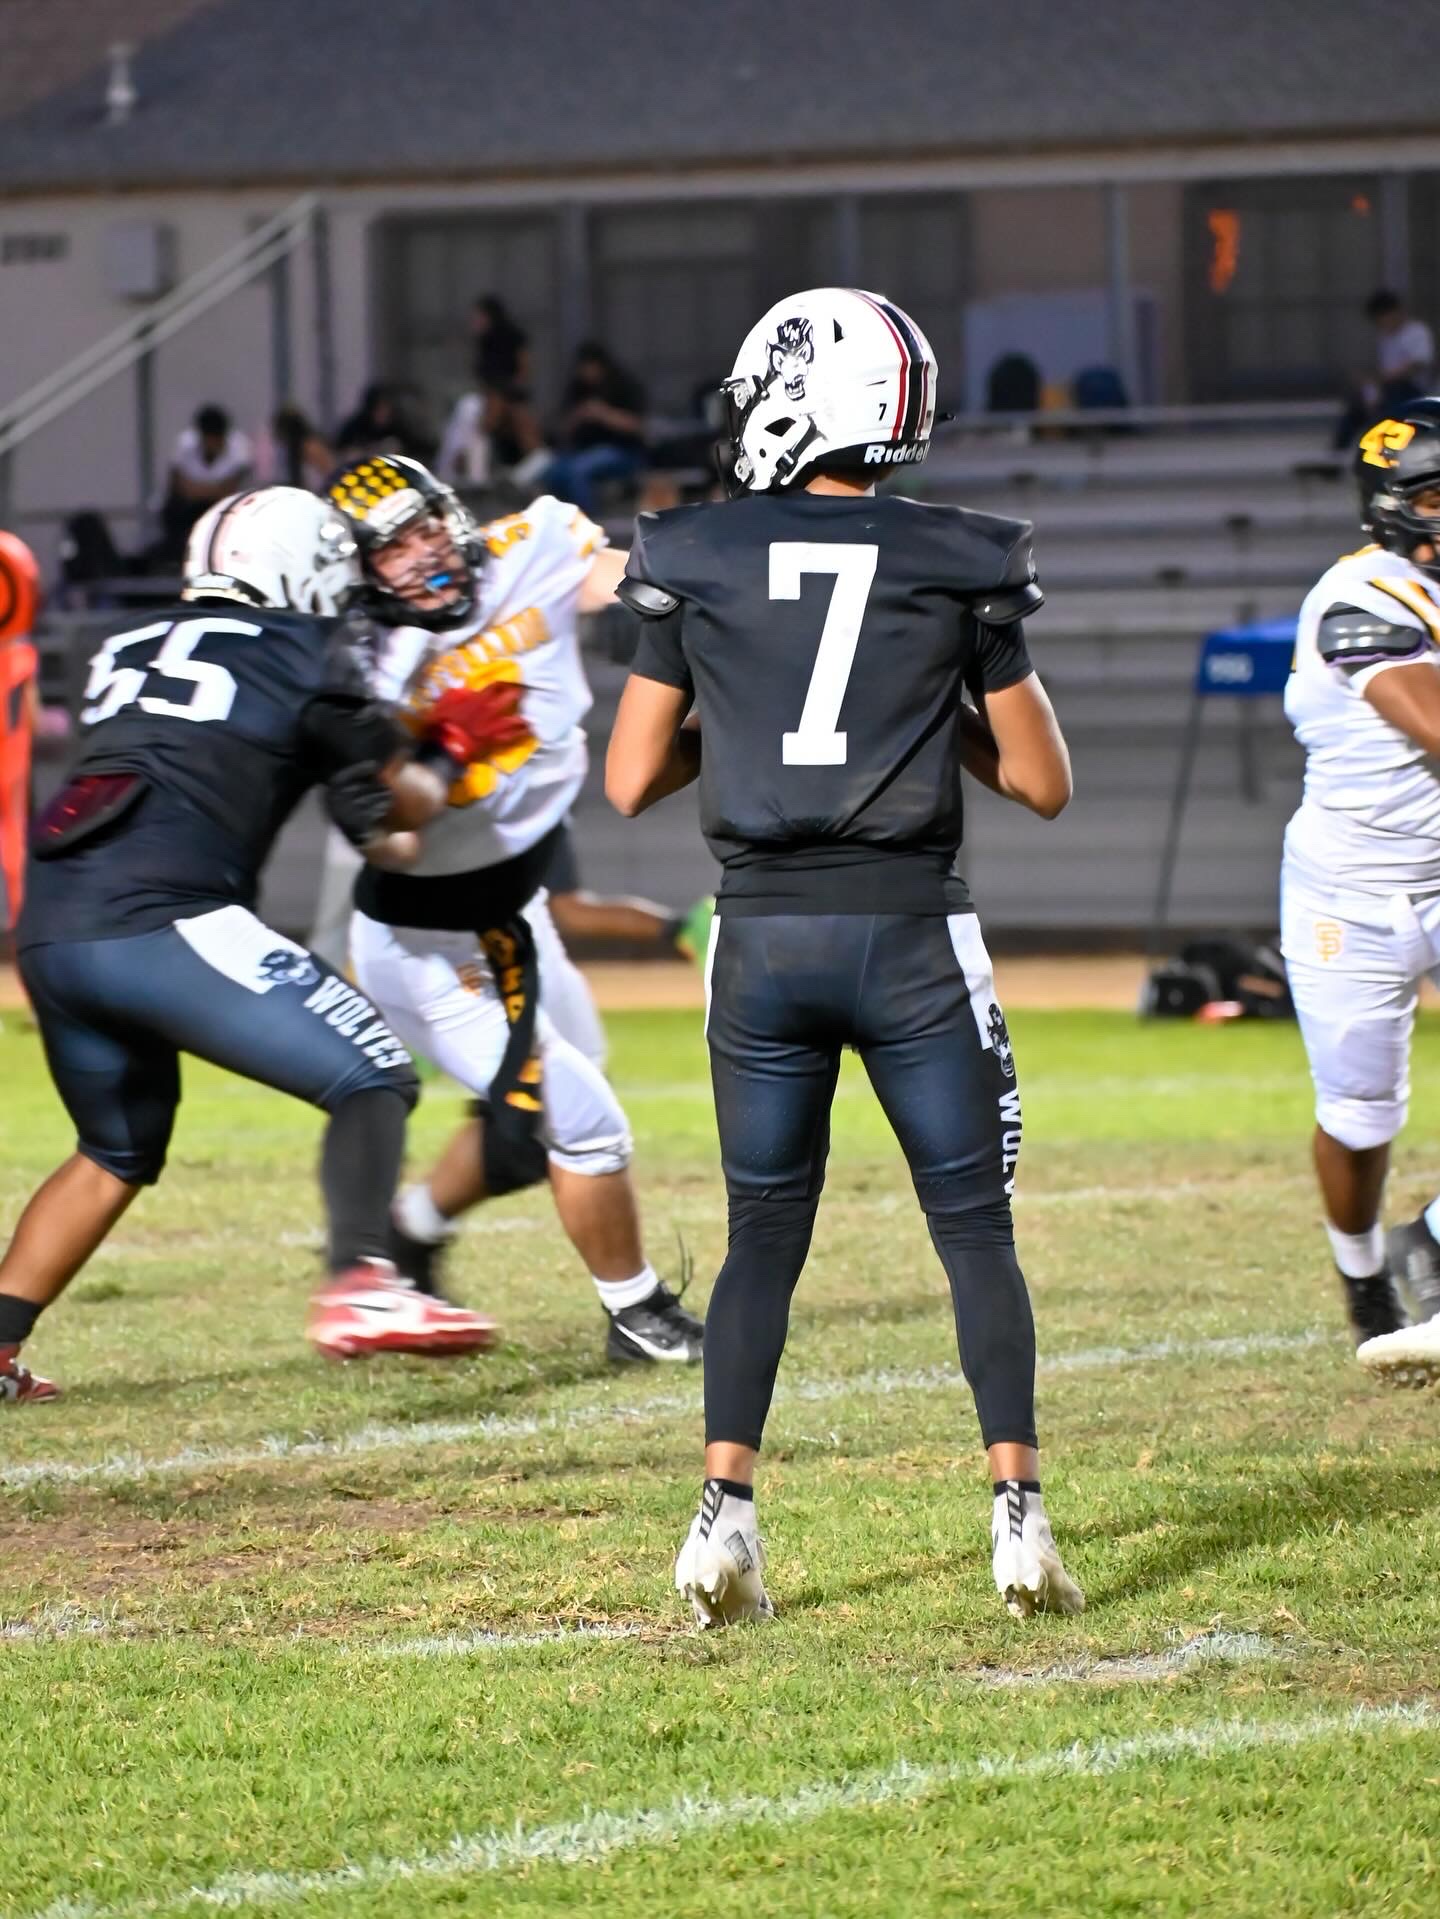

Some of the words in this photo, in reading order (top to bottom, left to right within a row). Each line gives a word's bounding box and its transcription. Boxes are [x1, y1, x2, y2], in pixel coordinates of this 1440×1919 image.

[783, 323, 801, 342] VN
[878, 402, 888, 421] 7
[80, 617, 264, 725] 55
[768, 541, 879, 766] 7
[303, 975, 413, 1069] WOLVES
